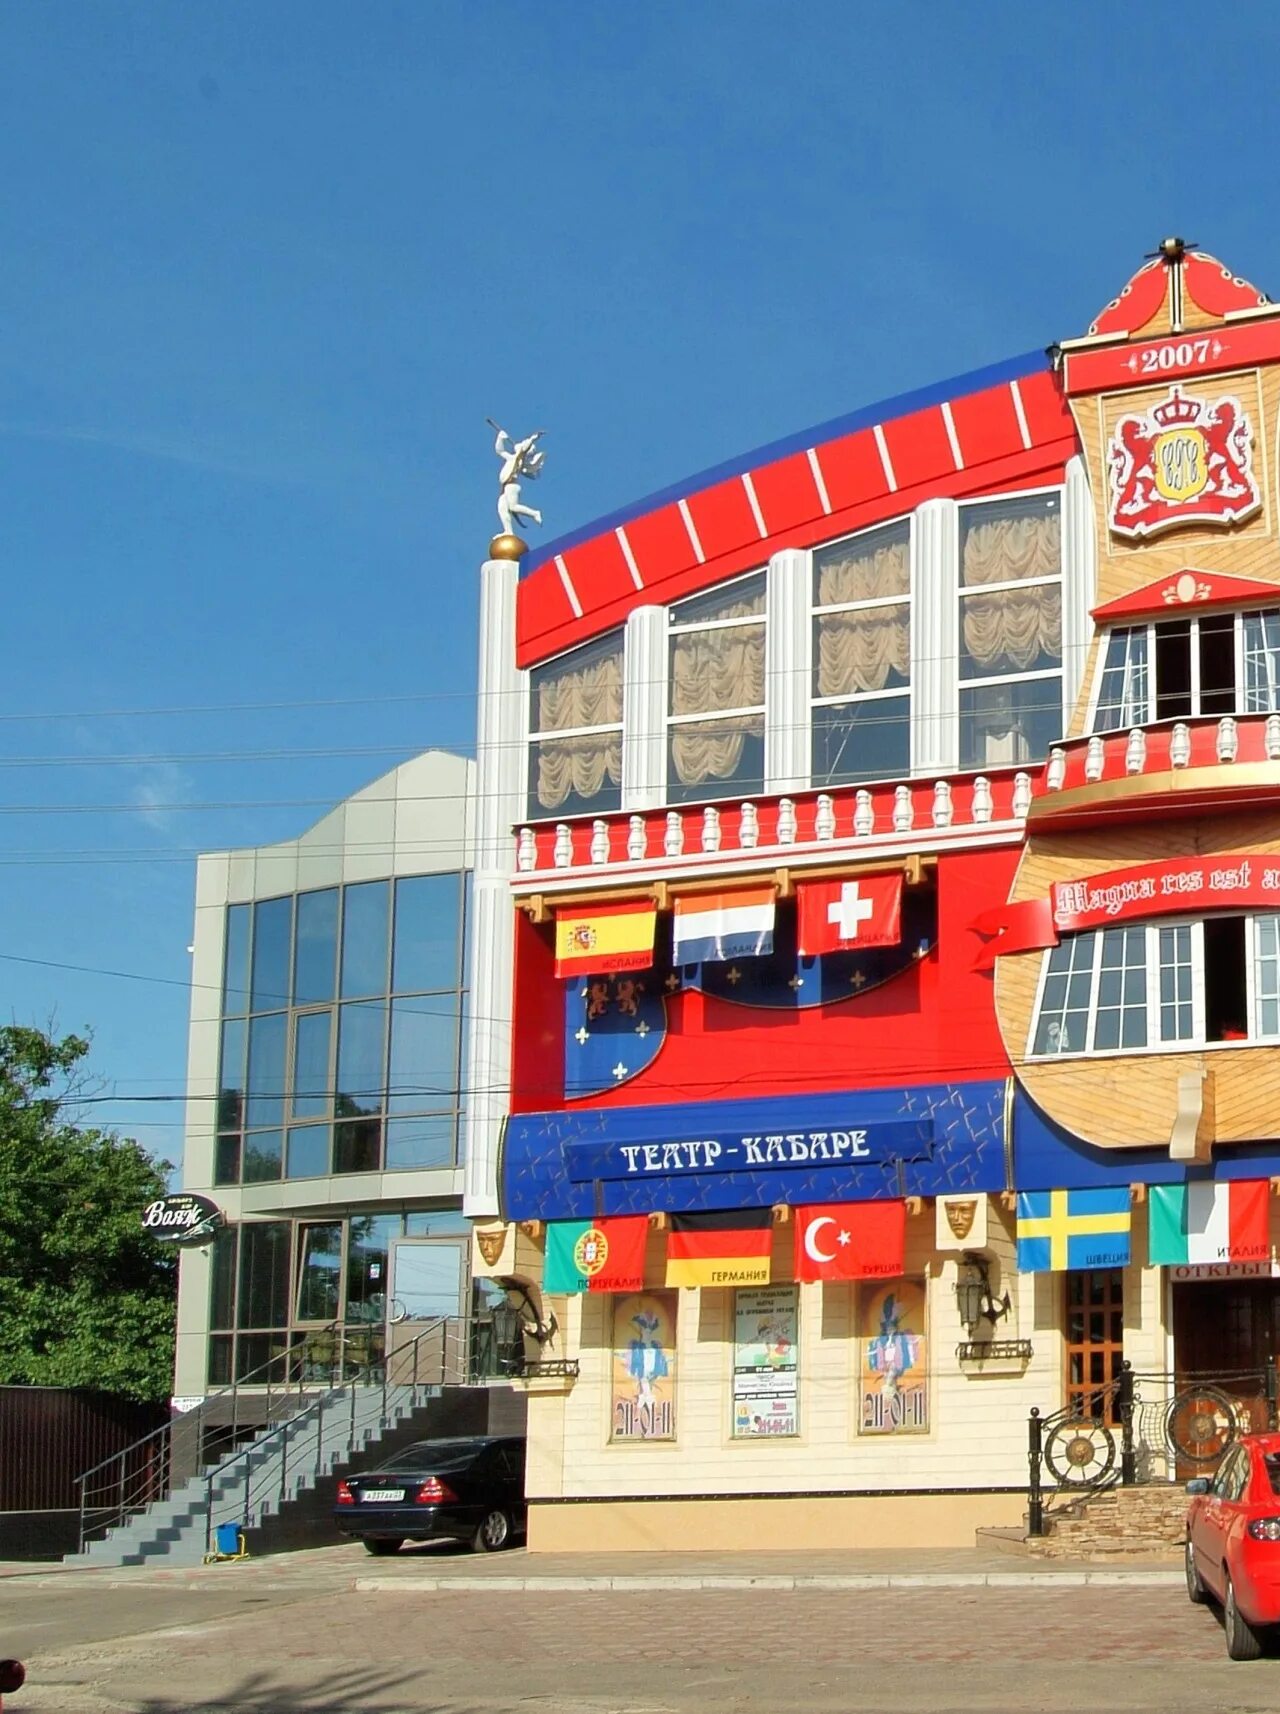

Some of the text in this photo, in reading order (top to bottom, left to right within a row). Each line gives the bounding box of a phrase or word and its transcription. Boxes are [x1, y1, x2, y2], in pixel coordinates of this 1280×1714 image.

[1141, 339, 1211, 373] 2007
[1054, 880, 1156, 924] Magna
[1160, 867, 1203, 895] res
[1208, 860, 1252, 890] est
[1217, 1244, 1268, 1258] ИТАЛИЯ
[1086, 1252, 1129, 1265] ШВЕЦИЯ
[711, 1269, 768, 1283] ГЕРМАНИЯ
[577, 1277, 645, 1290] ПОРТУГАЛИЯ
